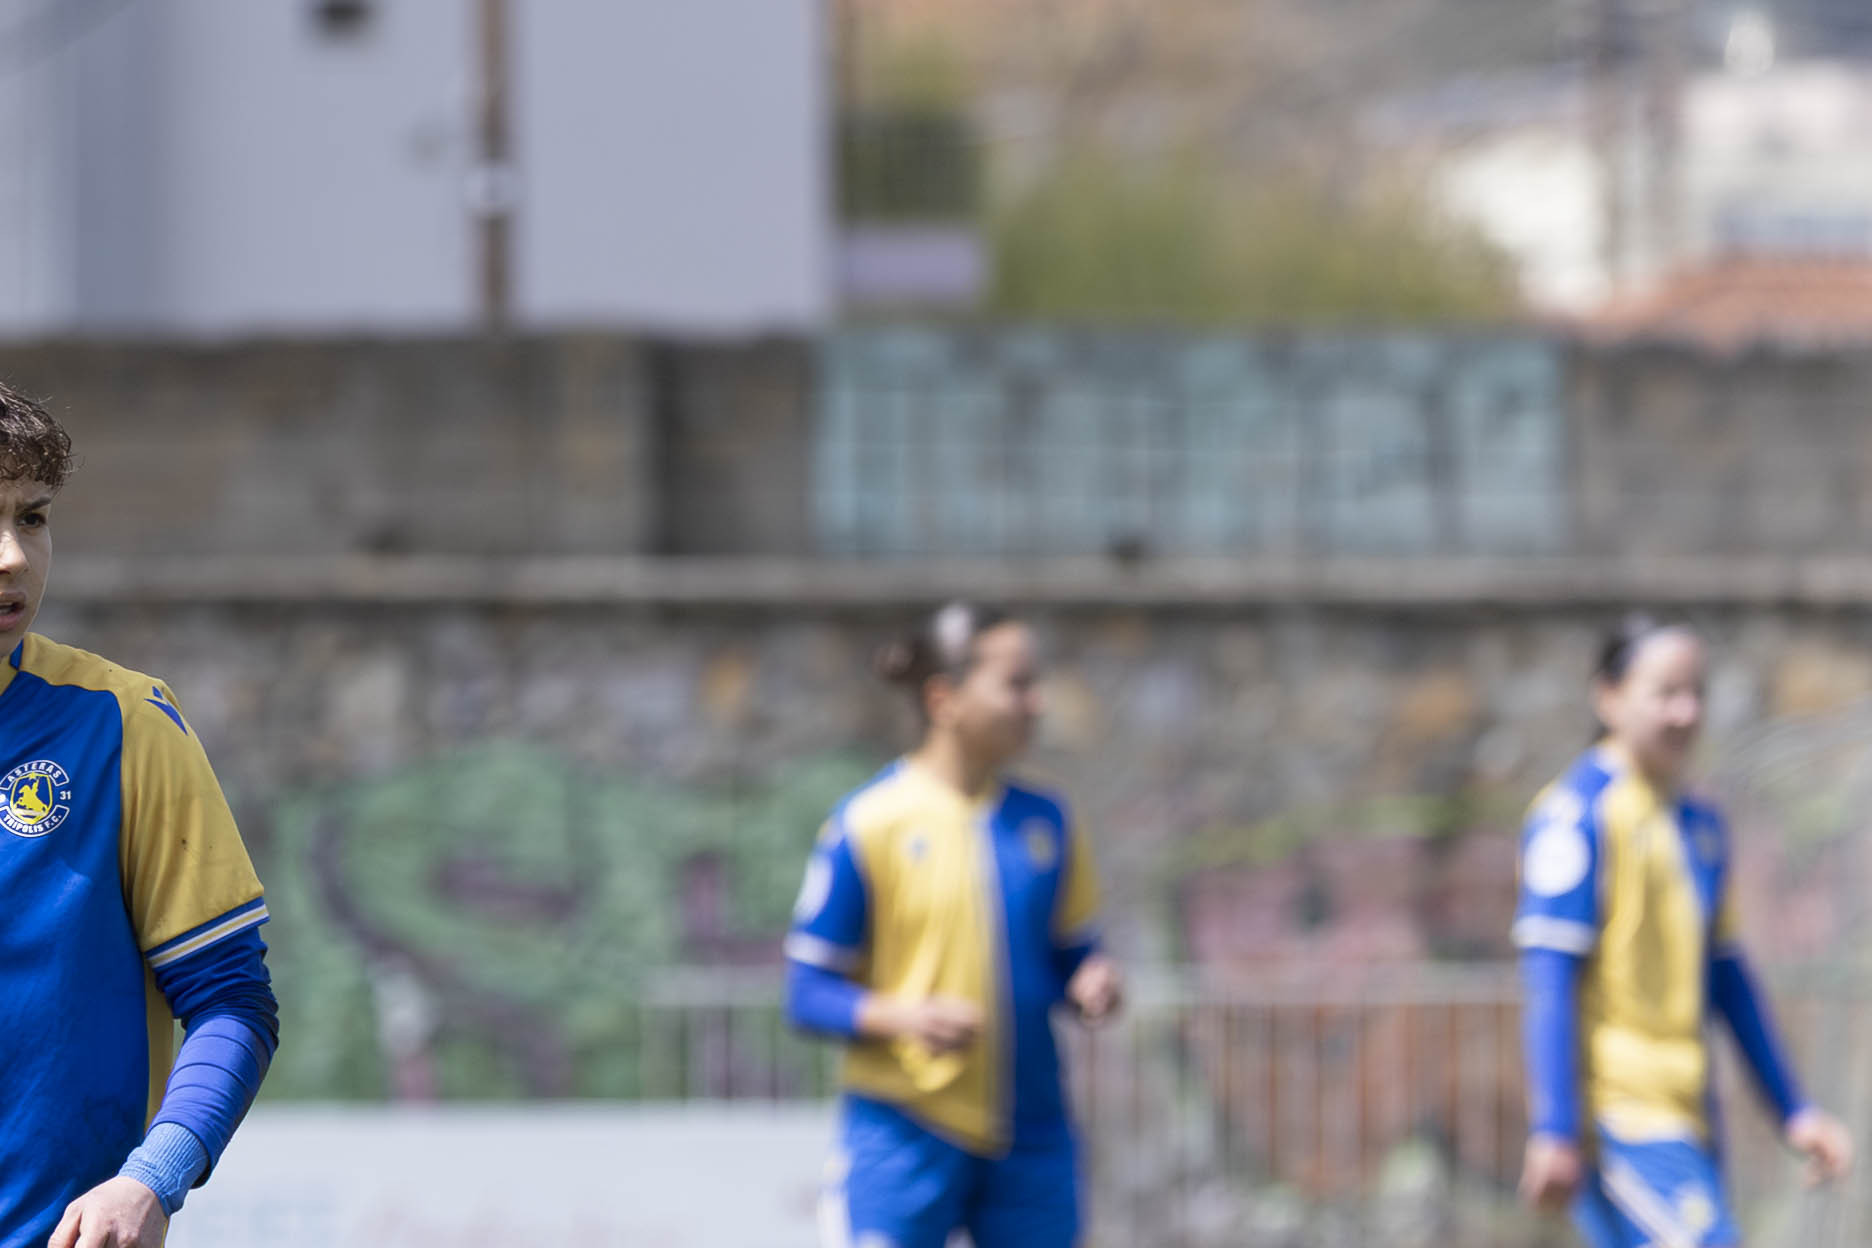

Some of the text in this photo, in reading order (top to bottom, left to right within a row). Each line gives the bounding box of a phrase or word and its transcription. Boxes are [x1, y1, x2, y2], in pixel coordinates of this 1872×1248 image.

[7, 762, 62, 782] ASTERAS
[59, 790, 72, 800] 31
[3, 814, 44, 833] TRIPOLIS
